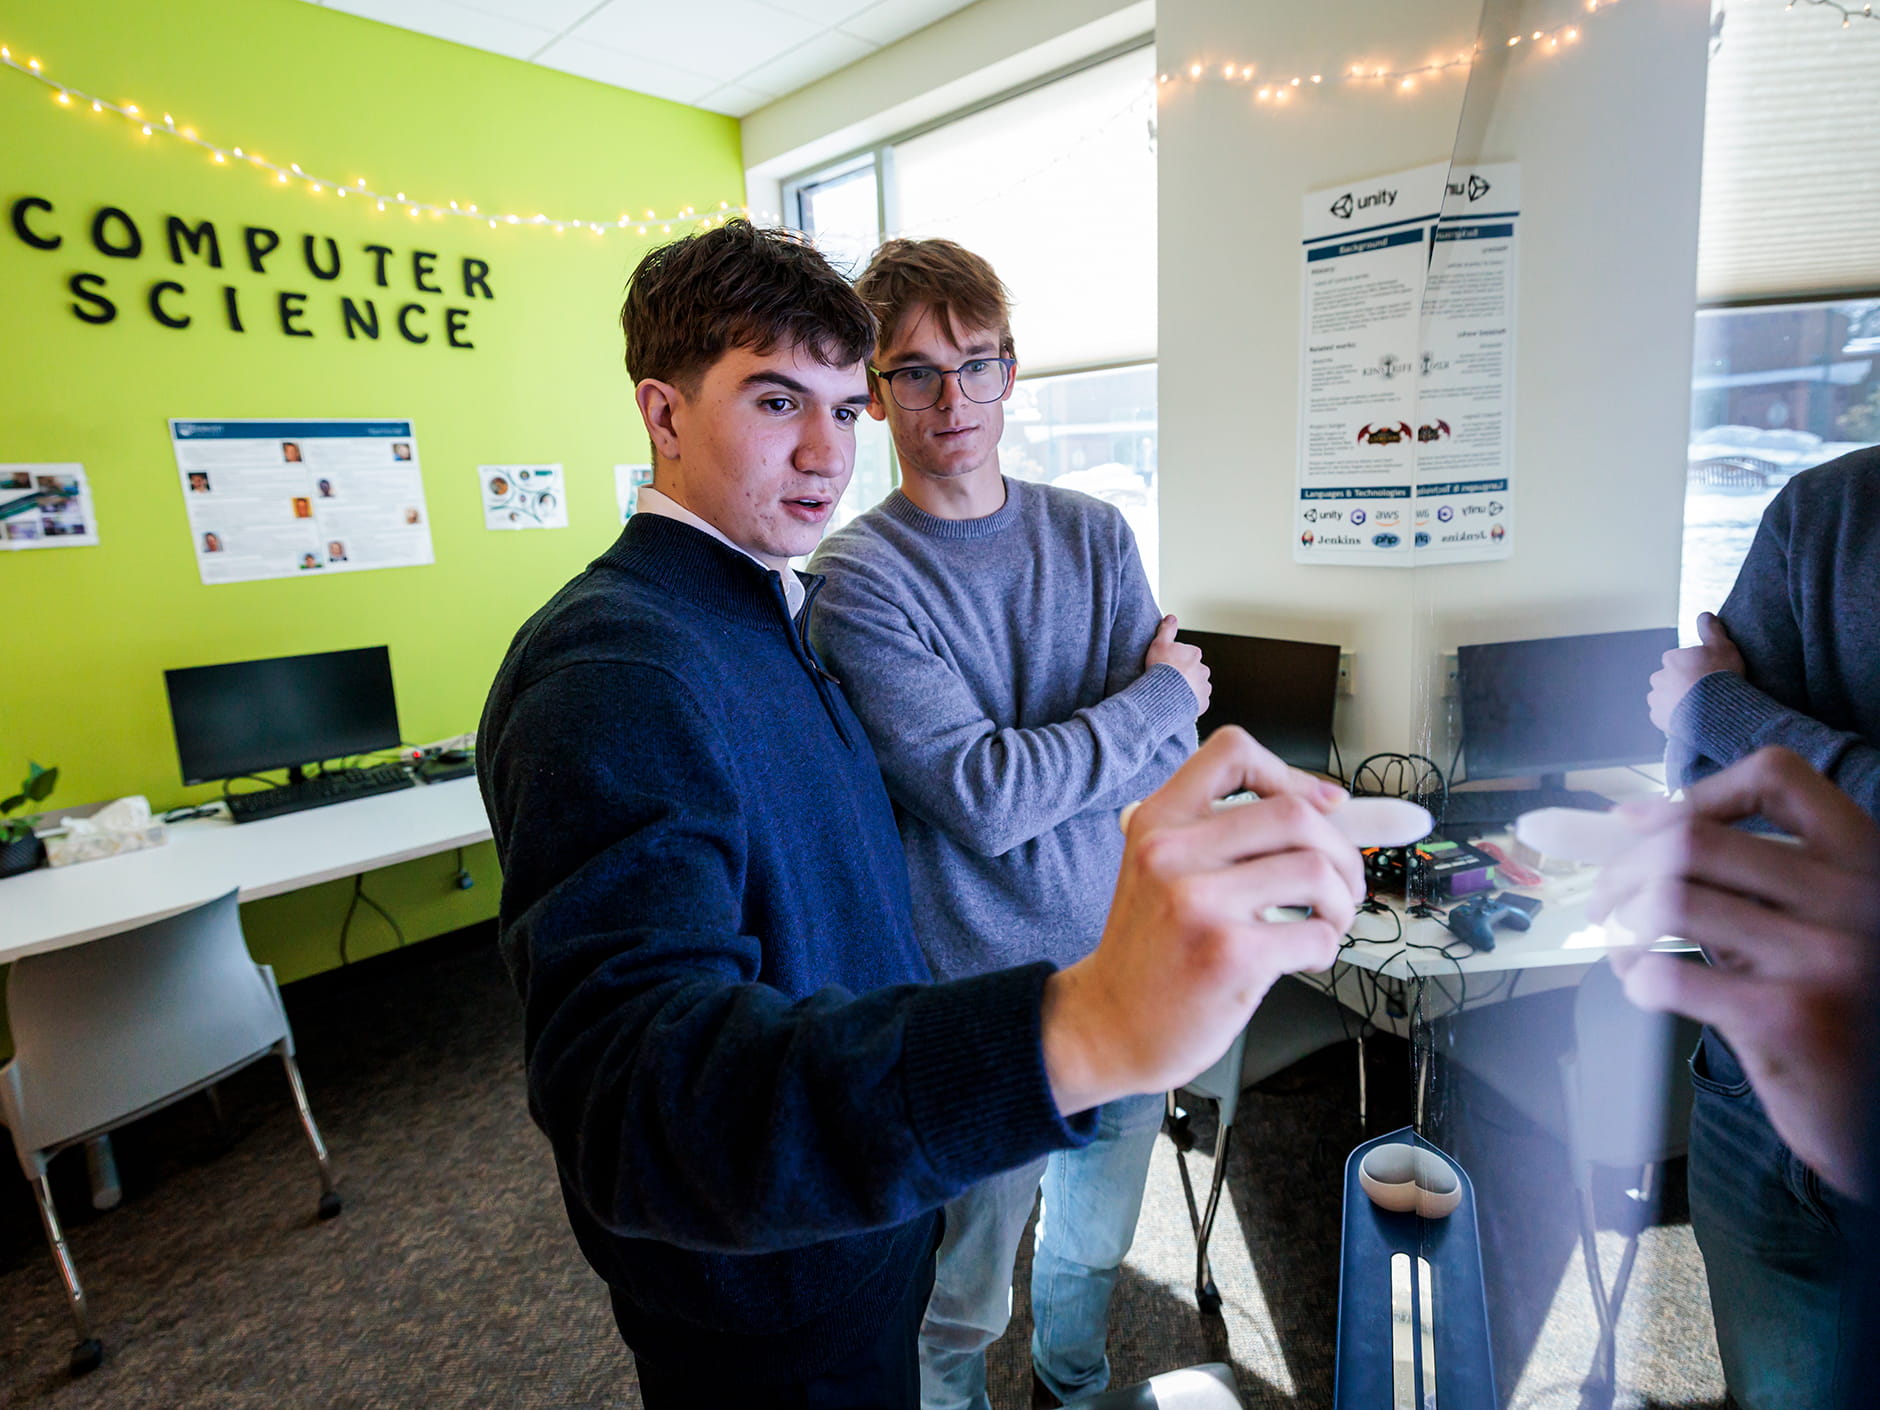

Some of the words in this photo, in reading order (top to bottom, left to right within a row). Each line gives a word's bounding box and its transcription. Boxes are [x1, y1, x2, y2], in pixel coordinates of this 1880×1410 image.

[1357, 189, 1398, 210] unity
[11, 197, 494, 300] COMPUTER
[1339, 238, 1388, 254] Background
[68, 273, 475, 349] SCIENCE
[1304, 489, 1344, 499] Languages
[1345, 489, 1353, 498] &
[1354, 487, 1406, 498] Technologies
[1320, 510, 1343, 521] unity
[1375, 511, 1400, 520] aws
[1317, 536, 1362, 545] Jenkins
[1375, 535, 1398, 546] php
